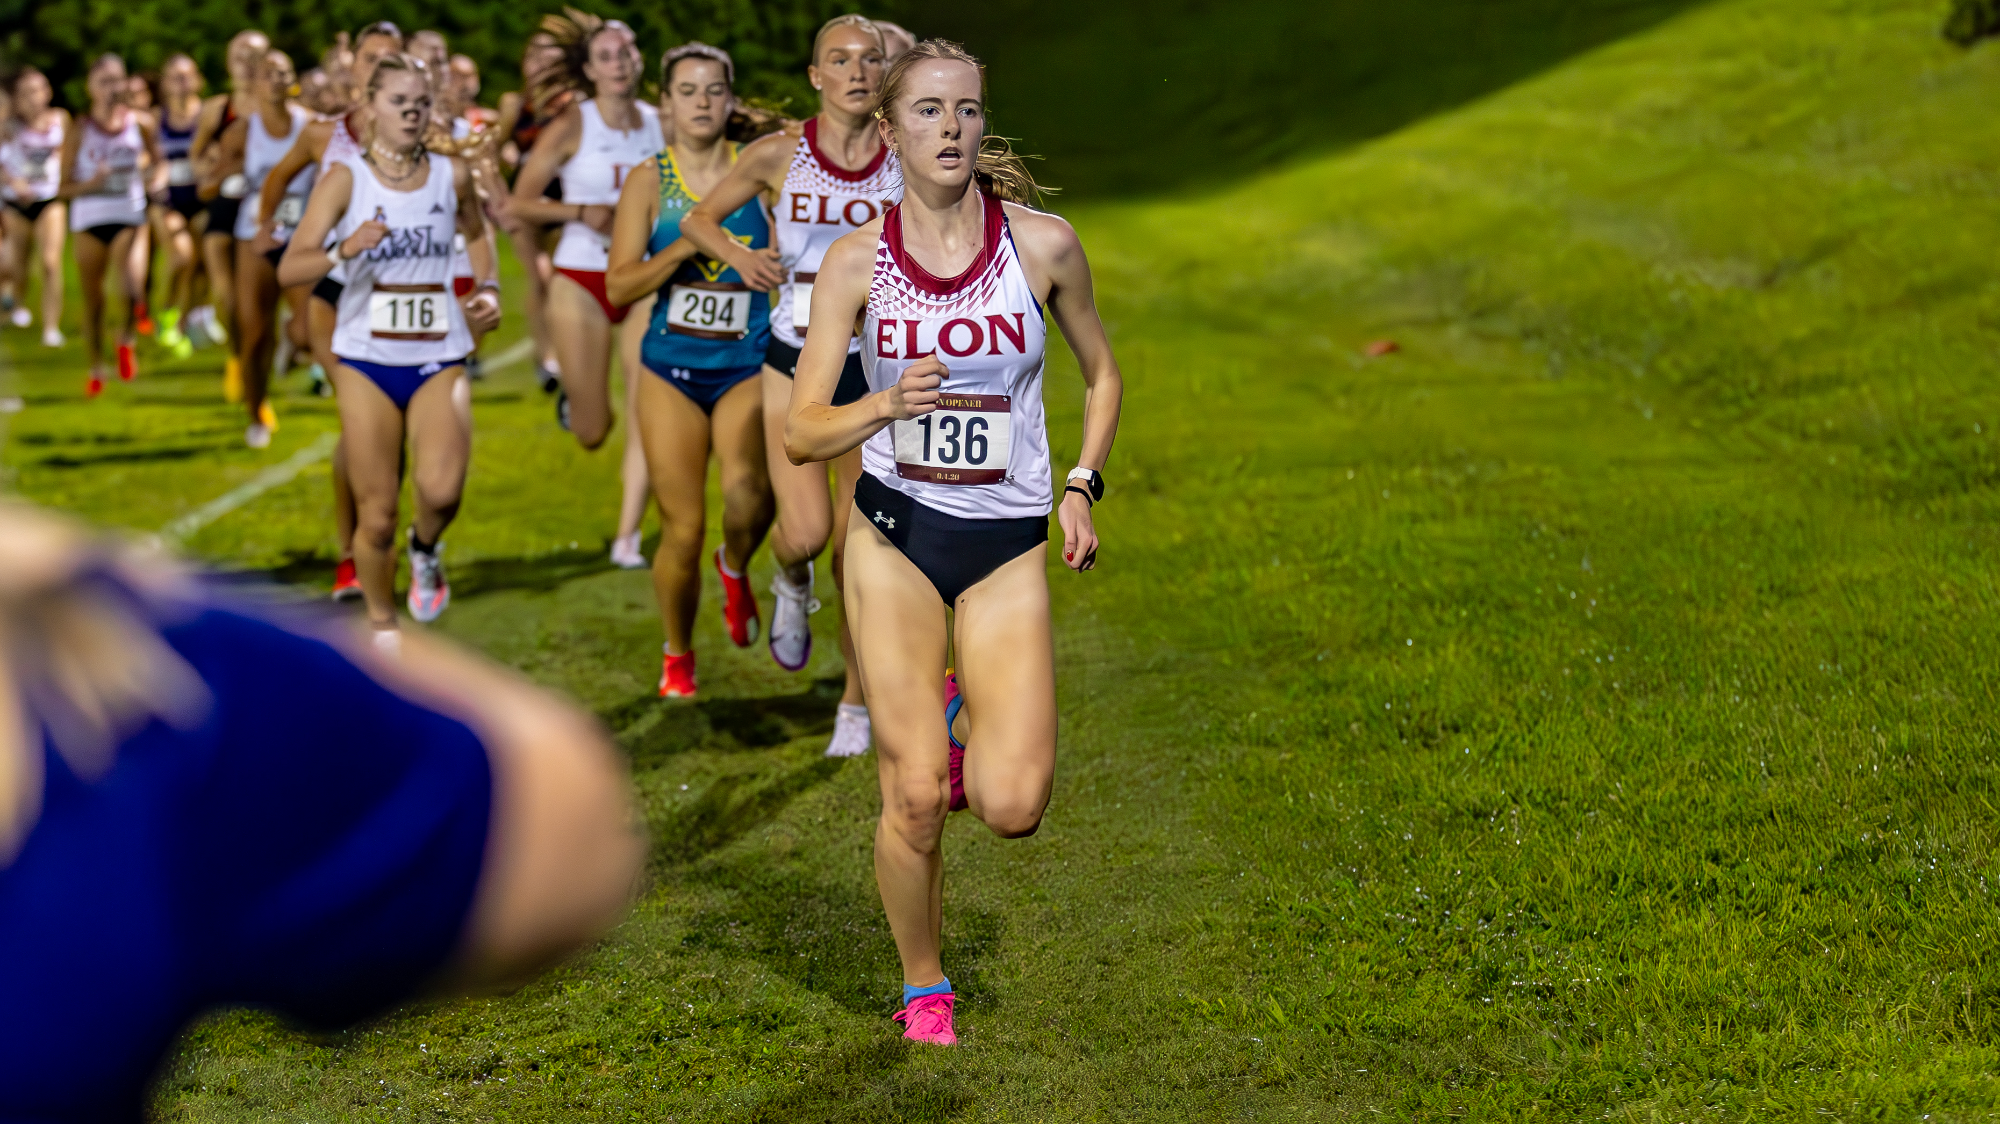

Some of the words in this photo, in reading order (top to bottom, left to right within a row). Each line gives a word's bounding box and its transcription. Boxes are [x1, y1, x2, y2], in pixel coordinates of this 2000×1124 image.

[389, 226, 433, 255] EAST
[388, 297, 434, 328] 116
[683, 292, 735, 329] 294
[877, 312, 1026, 360] ELON
[945, 398, 982, 408] OPENER
[917, 413, 989, 466] 136
